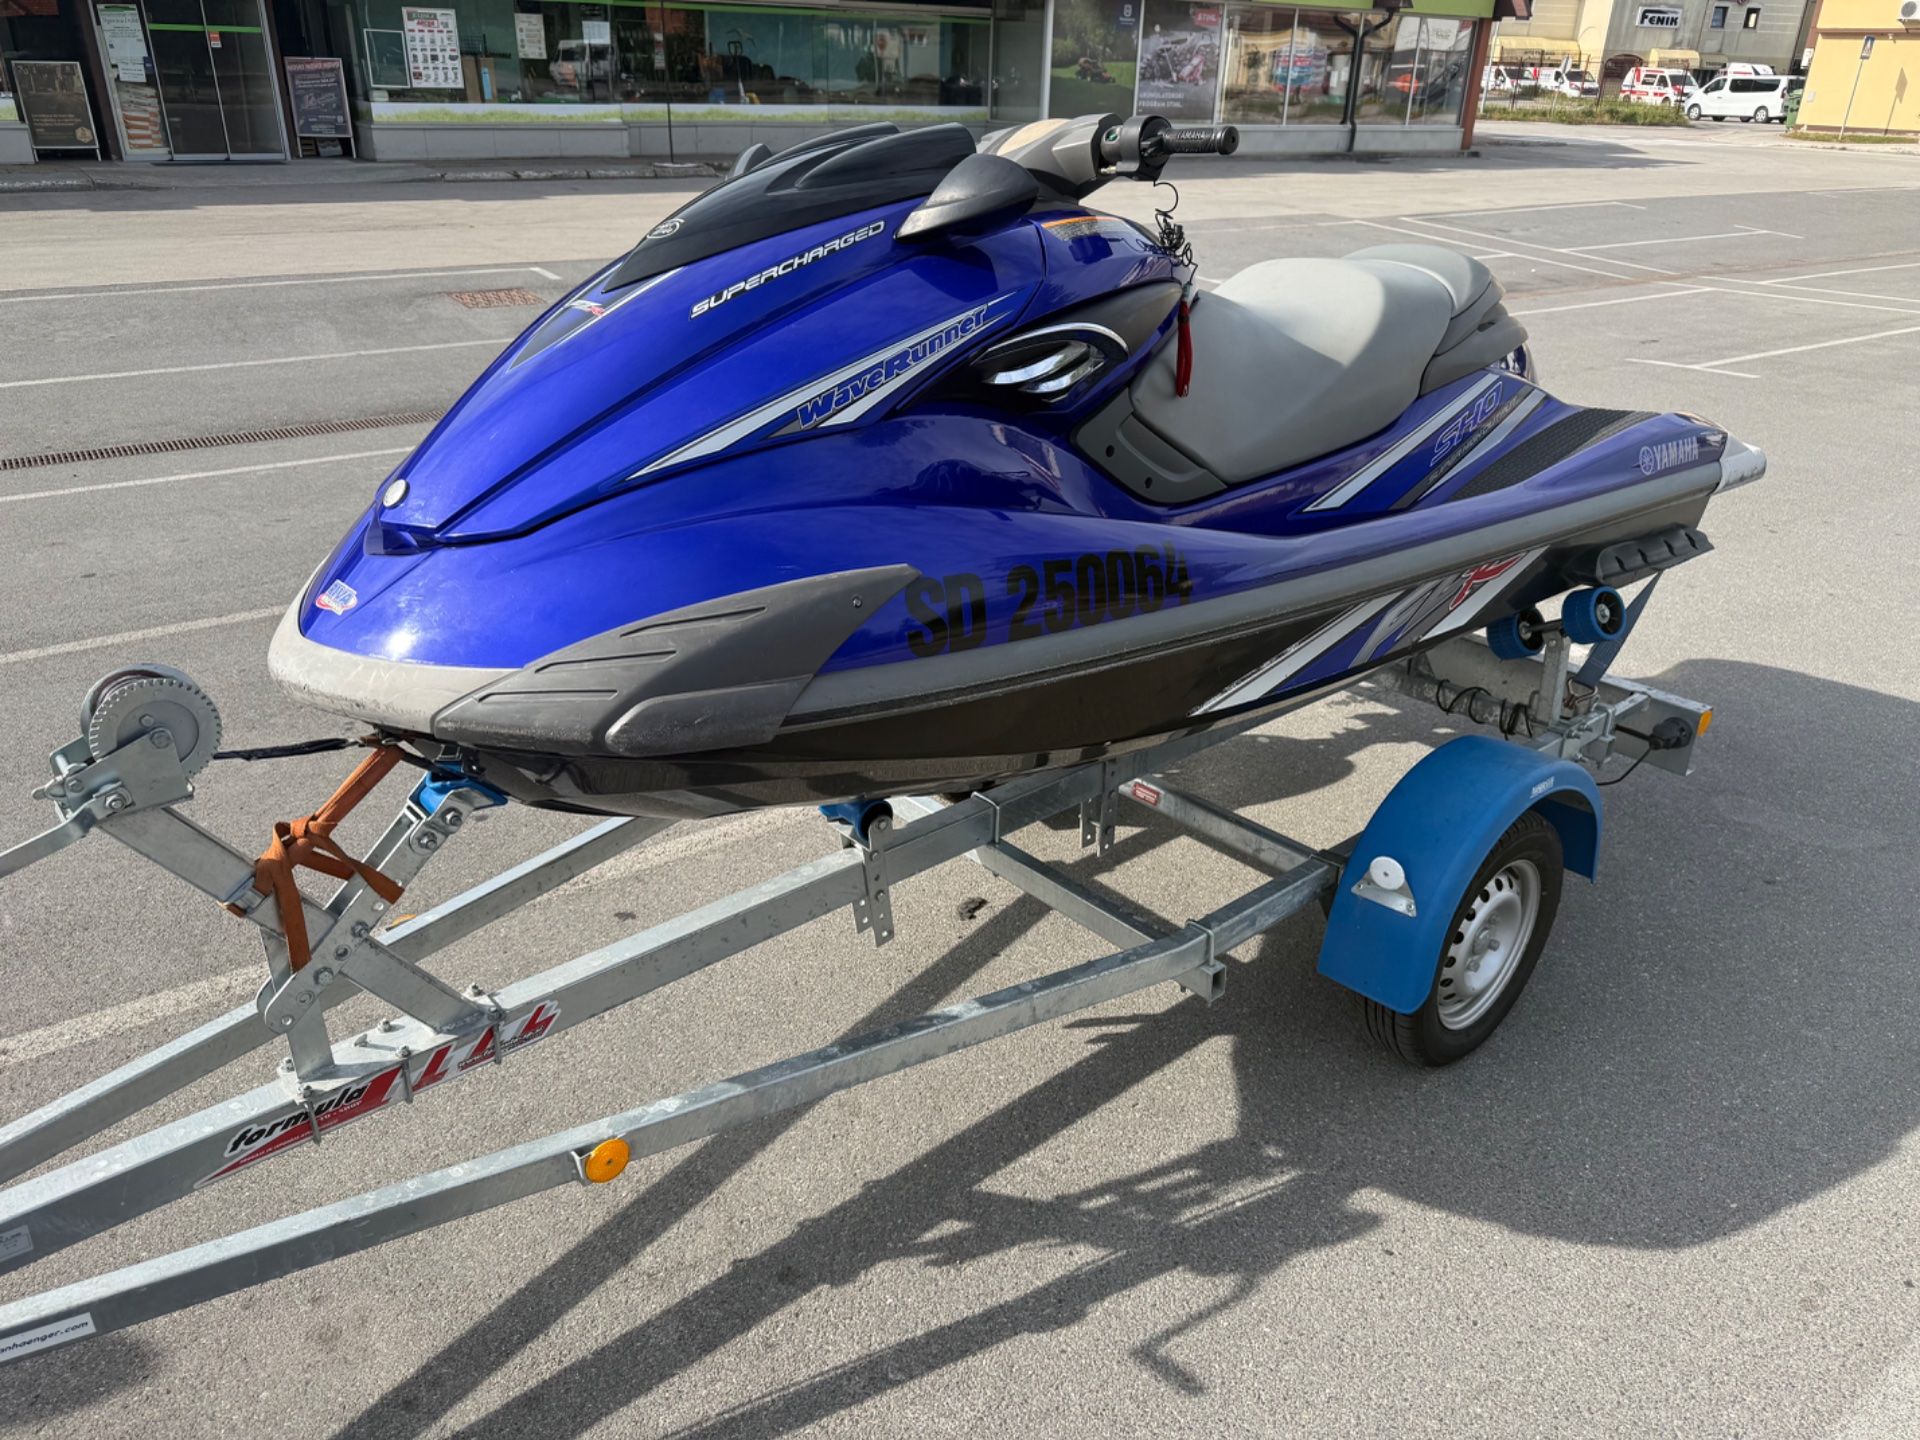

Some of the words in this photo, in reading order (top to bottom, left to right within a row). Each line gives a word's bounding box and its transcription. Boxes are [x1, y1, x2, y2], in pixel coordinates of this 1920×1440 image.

[690, 220, 885, 319] SUPERCHARGED
[797, 304, 989, 430] WaveRunner
[1429, 381, 1503, 467] SHO
[1653, 435, 1699, 471] YAMAHA
[904, 573, 988, 658] SD
[1007, 541, 1193, 643] 250064
[229, 1084, 371, 1153] formula
